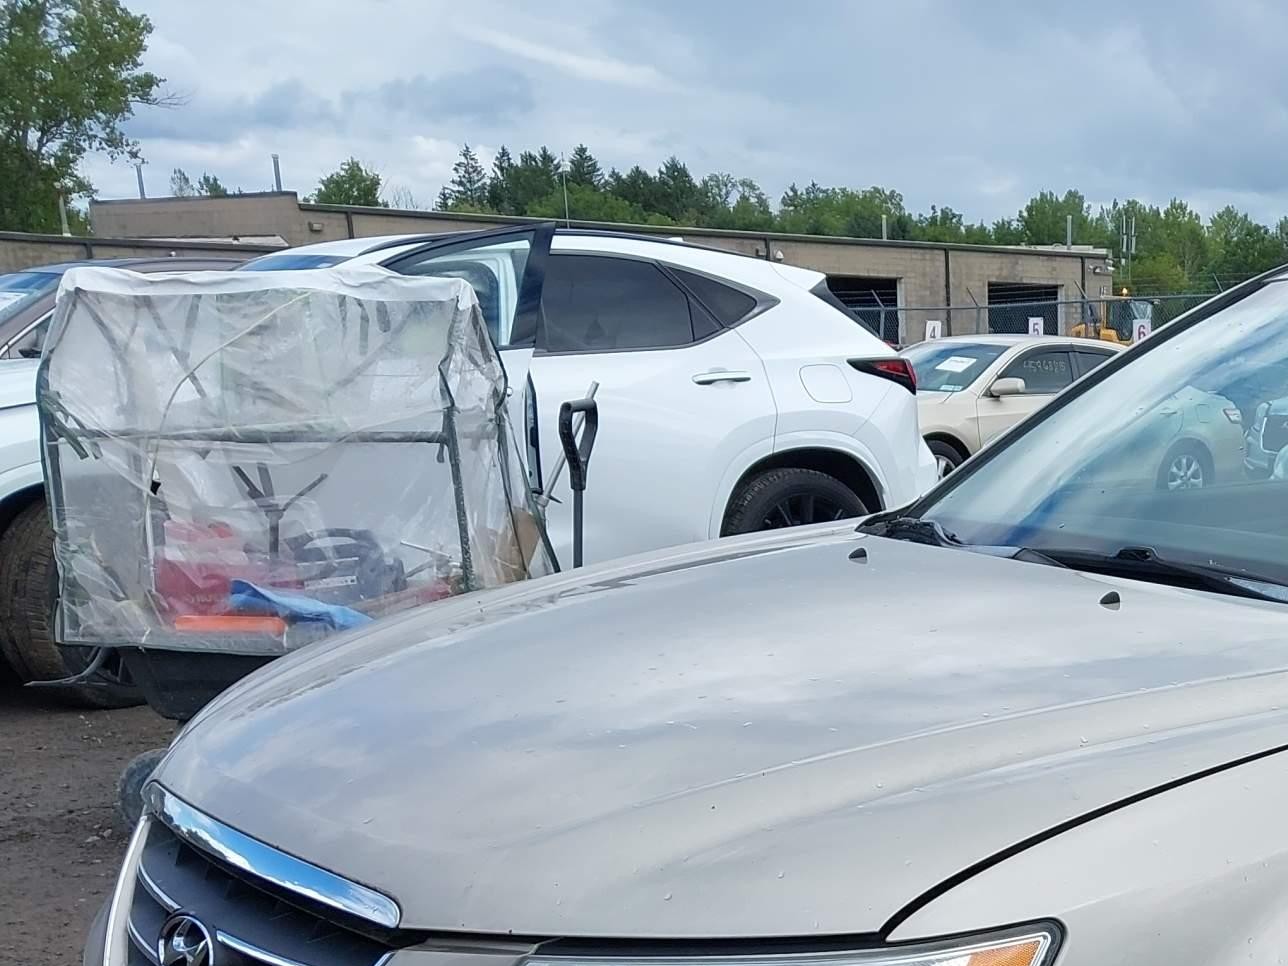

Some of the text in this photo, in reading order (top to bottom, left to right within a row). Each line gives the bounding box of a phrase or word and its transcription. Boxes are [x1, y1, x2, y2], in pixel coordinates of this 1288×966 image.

[929, 325, 937, 339] 4
[1032, 322, 1040, 336] 5
[1137, 324, 1146, 340] 6
